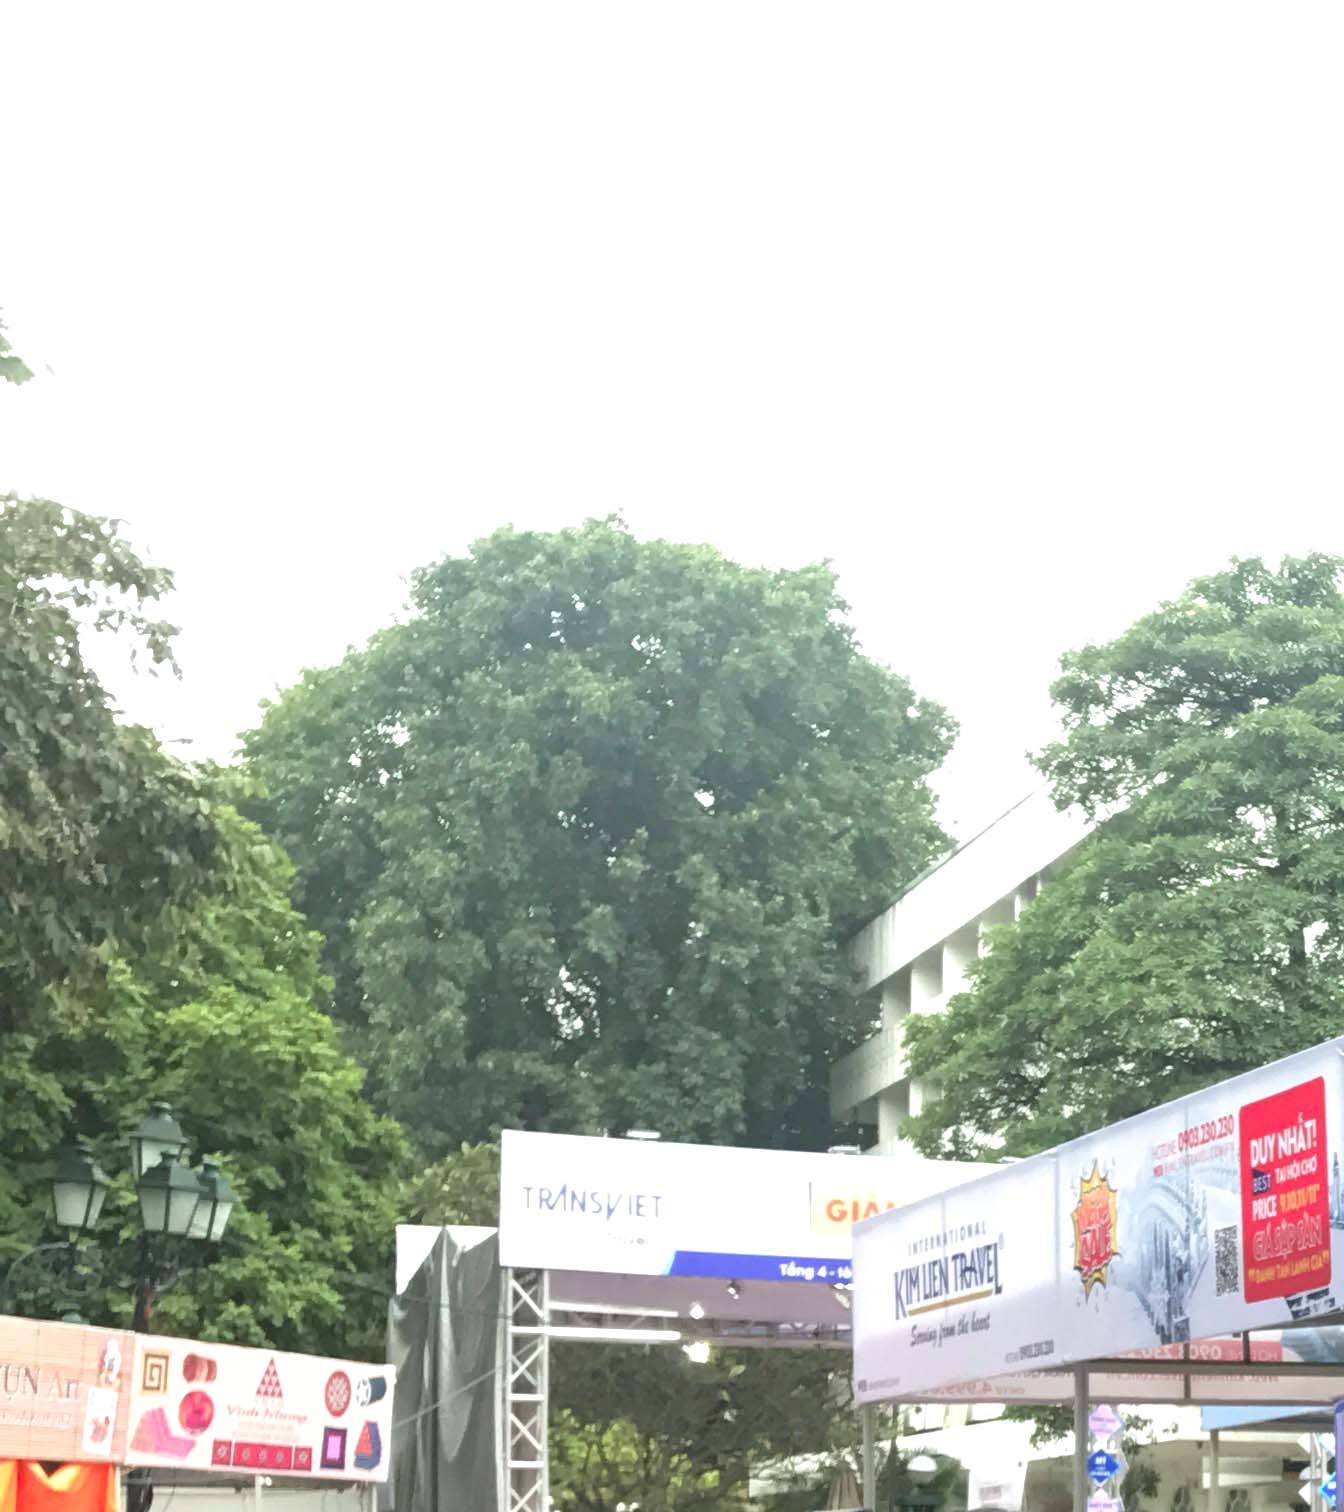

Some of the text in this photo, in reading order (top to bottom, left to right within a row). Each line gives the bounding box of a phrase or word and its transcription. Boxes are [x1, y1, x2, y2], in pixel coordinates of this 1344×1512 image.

[1250, 1135, 1277, 1168] DUY
[523, 1184, 663, 1221] TRANSVIET
[1252, 1195, 1277, 1221] PRICE
[909, 1221, 986, 1256] INTERNATIONAL
[894, 1243, 1002, 1320] KIM LIEN TRAVEL
